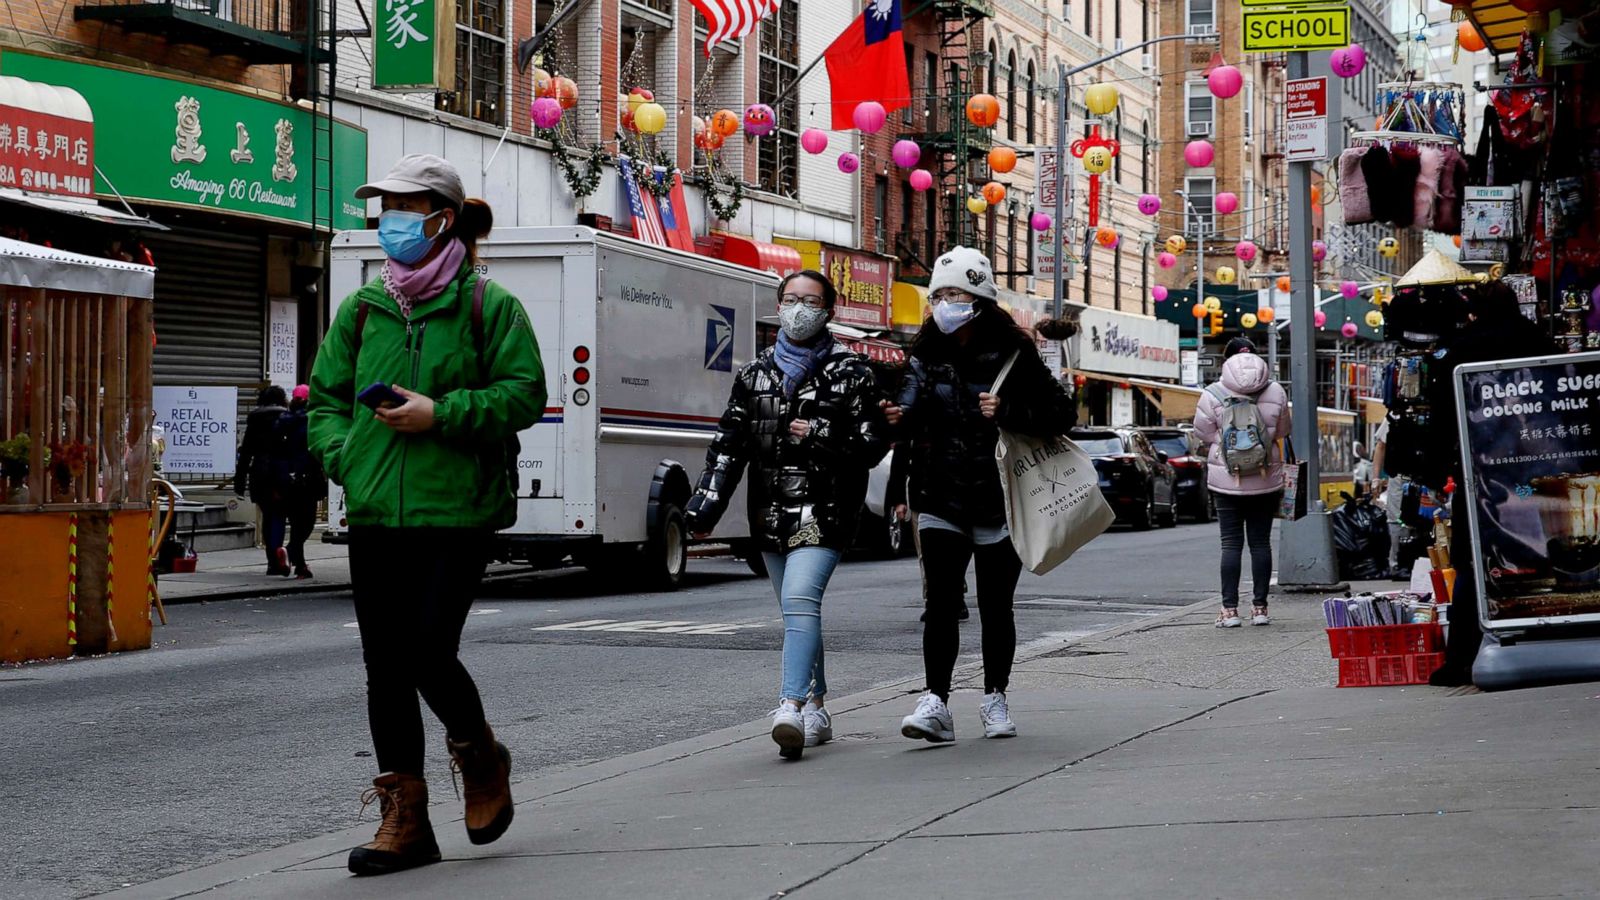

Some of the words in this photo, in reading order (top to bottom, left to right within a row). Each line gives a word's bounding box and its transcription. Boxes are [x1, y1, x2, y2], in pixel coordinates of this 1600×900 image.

[1250, 17, 1341, 40] SCHOOL
[1287, 84, 1295, 92] NO
[1296, 81, 1320, 91] STANDING
[1296, 122, 1317, 130] PARKING
[1288, 133, 1308, 141] Anytime
[1090, 152, 1104, 167] 福
[170, 169, 226, 205] Amazing
[228, 178, 246, 200] 66
[248, 181, 297, 208] Restaurant
[620, 284, 630, 301] We
[631, 287, 651, 305] Deliver
[652, 291, 661, 307] For
[272, 322, 295, 335] RETAIL
[272, 335, 294, 348] SPACE
[276, 349, 290, 361] FOR
[273, 361, 293, 374] LEASE
[1481, 380, 1543, 400] BLACK
[171, 408, 213, 420] RETAIL
[1483, 401, 1543, 418] OOLONG
[201, 421, 228, 433] FOR
[172, 434, 211, 446] LEASE
[1038, 503, 1053, 514] THE
[1055, 495, 1067, 506] ART
[1074, 482, 1092, 494] SOUL
[1049, 509, 1059, 517] OF
[1060, 492, 1089, 512] COOKING
